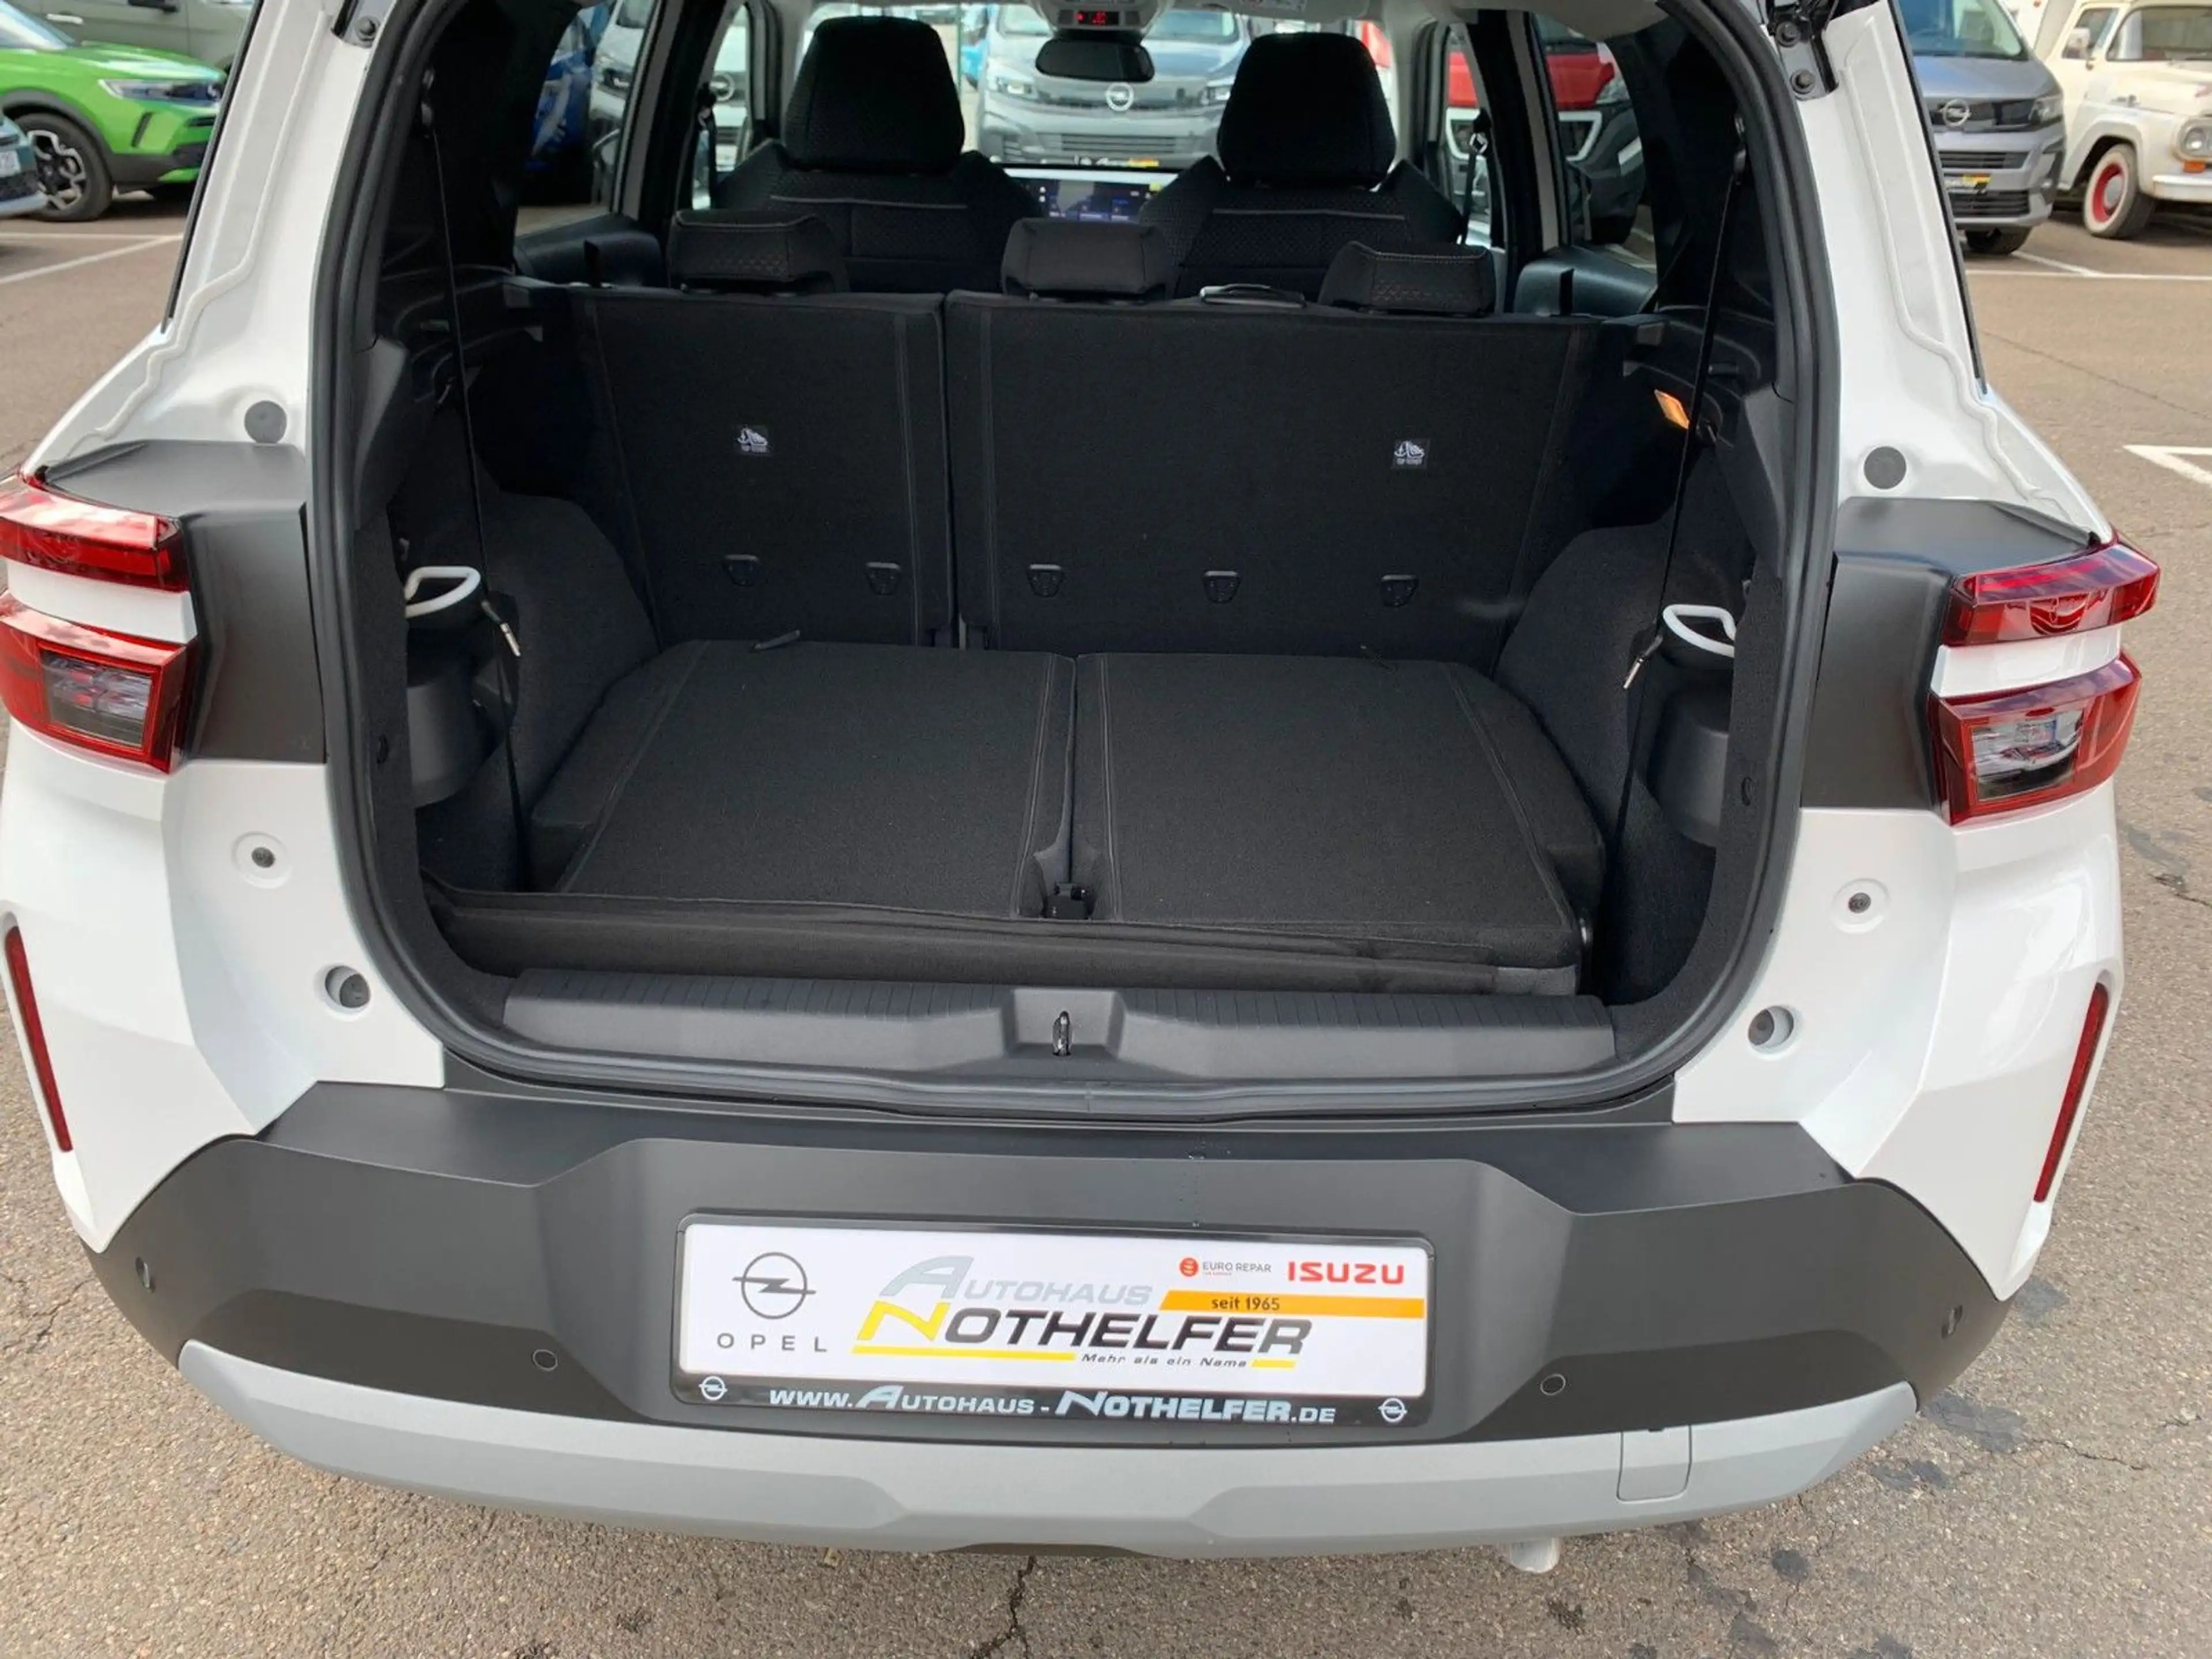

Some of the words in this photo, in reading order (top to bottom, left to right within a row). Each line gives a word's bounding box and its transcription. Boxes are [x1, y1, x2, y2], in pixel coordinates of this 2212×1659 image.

[1202, 1262, 1233, 1271] EURO
[1236, 1263, 1272, 1272] REPAR
[1288, 1261, 1404, 1284] ISUZU
[880, 1255, 1153, 1306] AUTOHAUS
[1211, 1297, 1240, 1310] seit
[1245, 1297, 1280, 1310] 1965
[857, 1300, 1312, 1354] NOTHELFER
[717, 1333, 827, 1353] OPEL
[1081, 1353, 1126, 1363] Mehr
[1134, 1355, 1158, 1365] als
[1166, 1356, 1191, 1365] ein
[1199, 1358, 1247, 1368] Name
